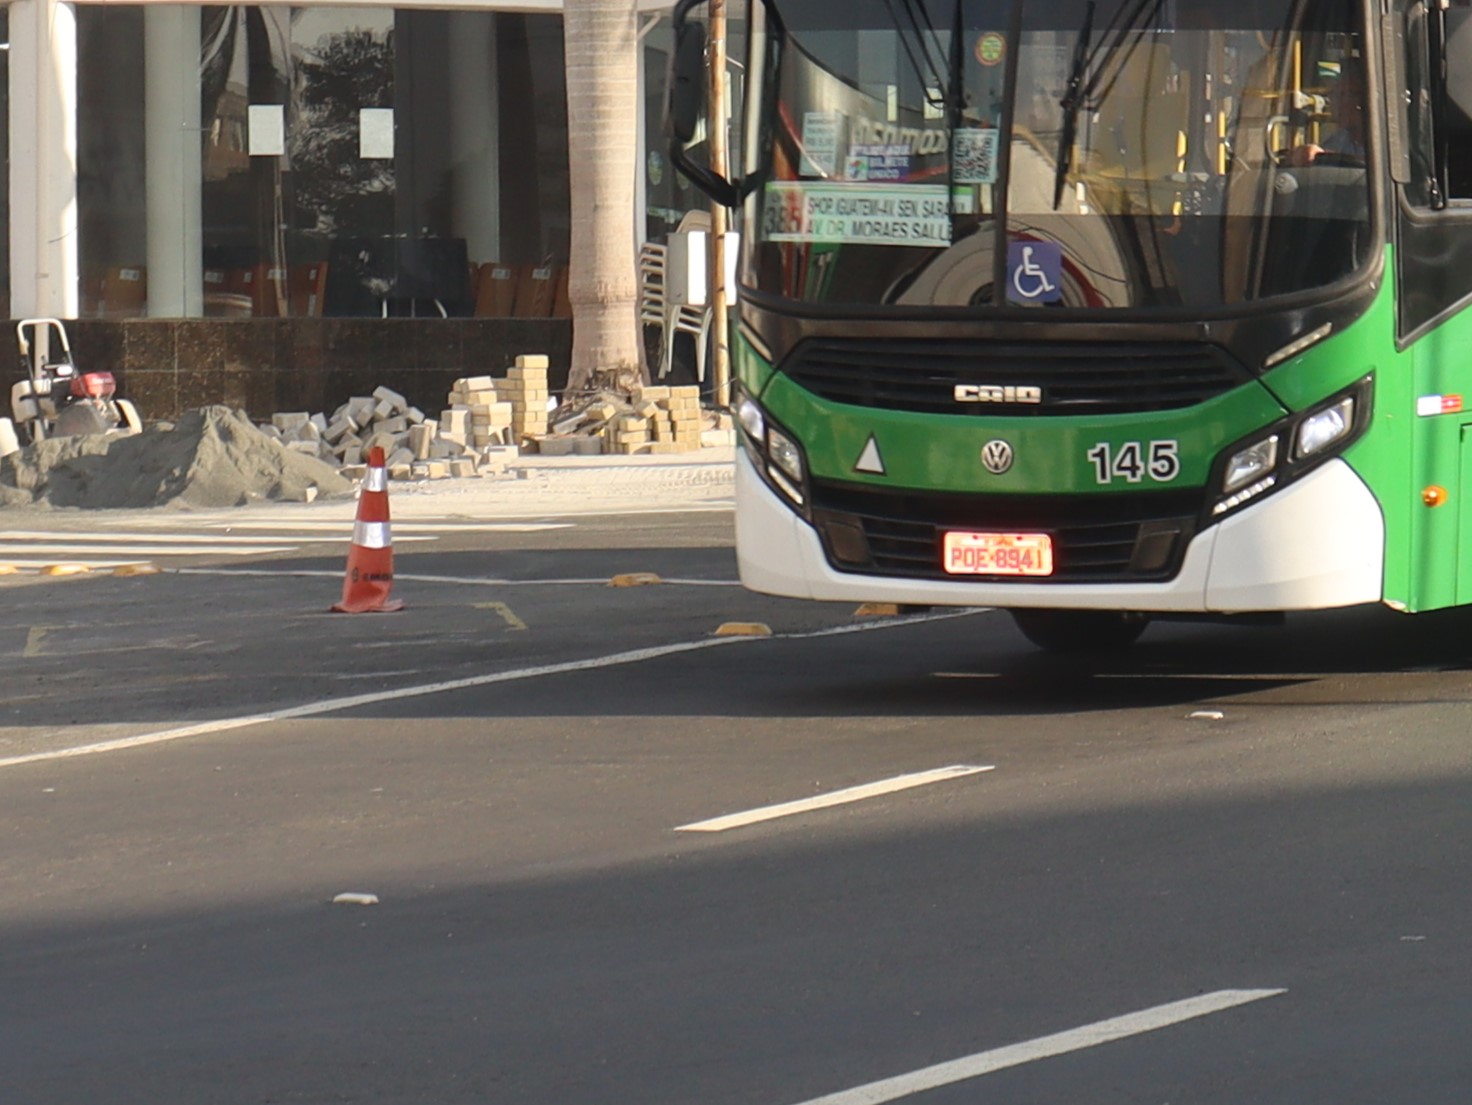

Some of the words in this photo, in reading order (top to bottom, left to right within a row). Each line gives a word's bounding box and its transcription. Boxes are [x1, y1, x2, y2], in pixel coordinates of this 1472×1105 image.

[852, 220, 908, 238] MORAES
[954, 384, 1042, 404] CAIO
[1087, 439, 1180, 484] 145
